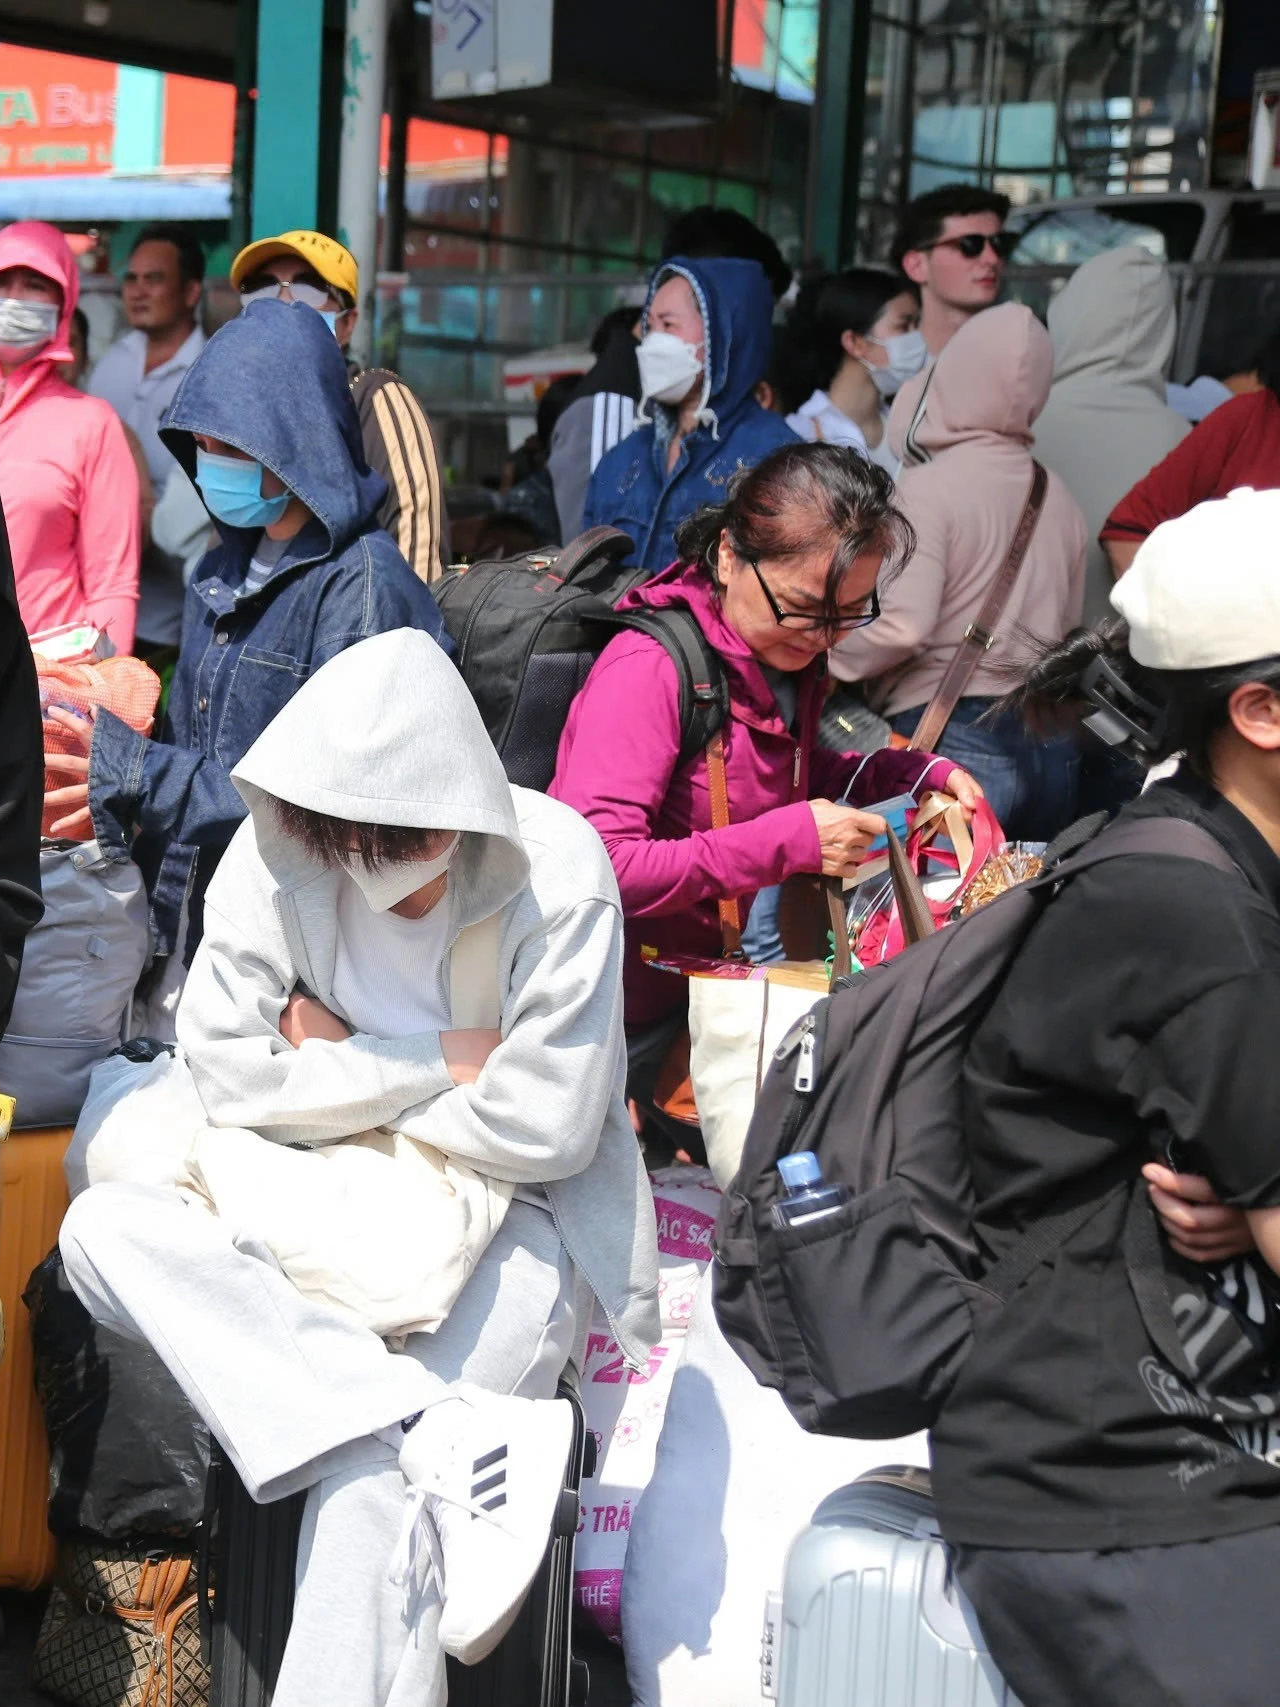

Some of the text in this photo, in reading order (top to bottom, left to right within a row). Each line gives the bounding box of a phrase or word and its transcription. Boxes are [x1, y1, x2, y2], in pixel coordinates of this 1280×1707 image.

[657, 1212, 715, 1247] ẶC SẢ
[580, 1577, 616, 1606] THẾ
